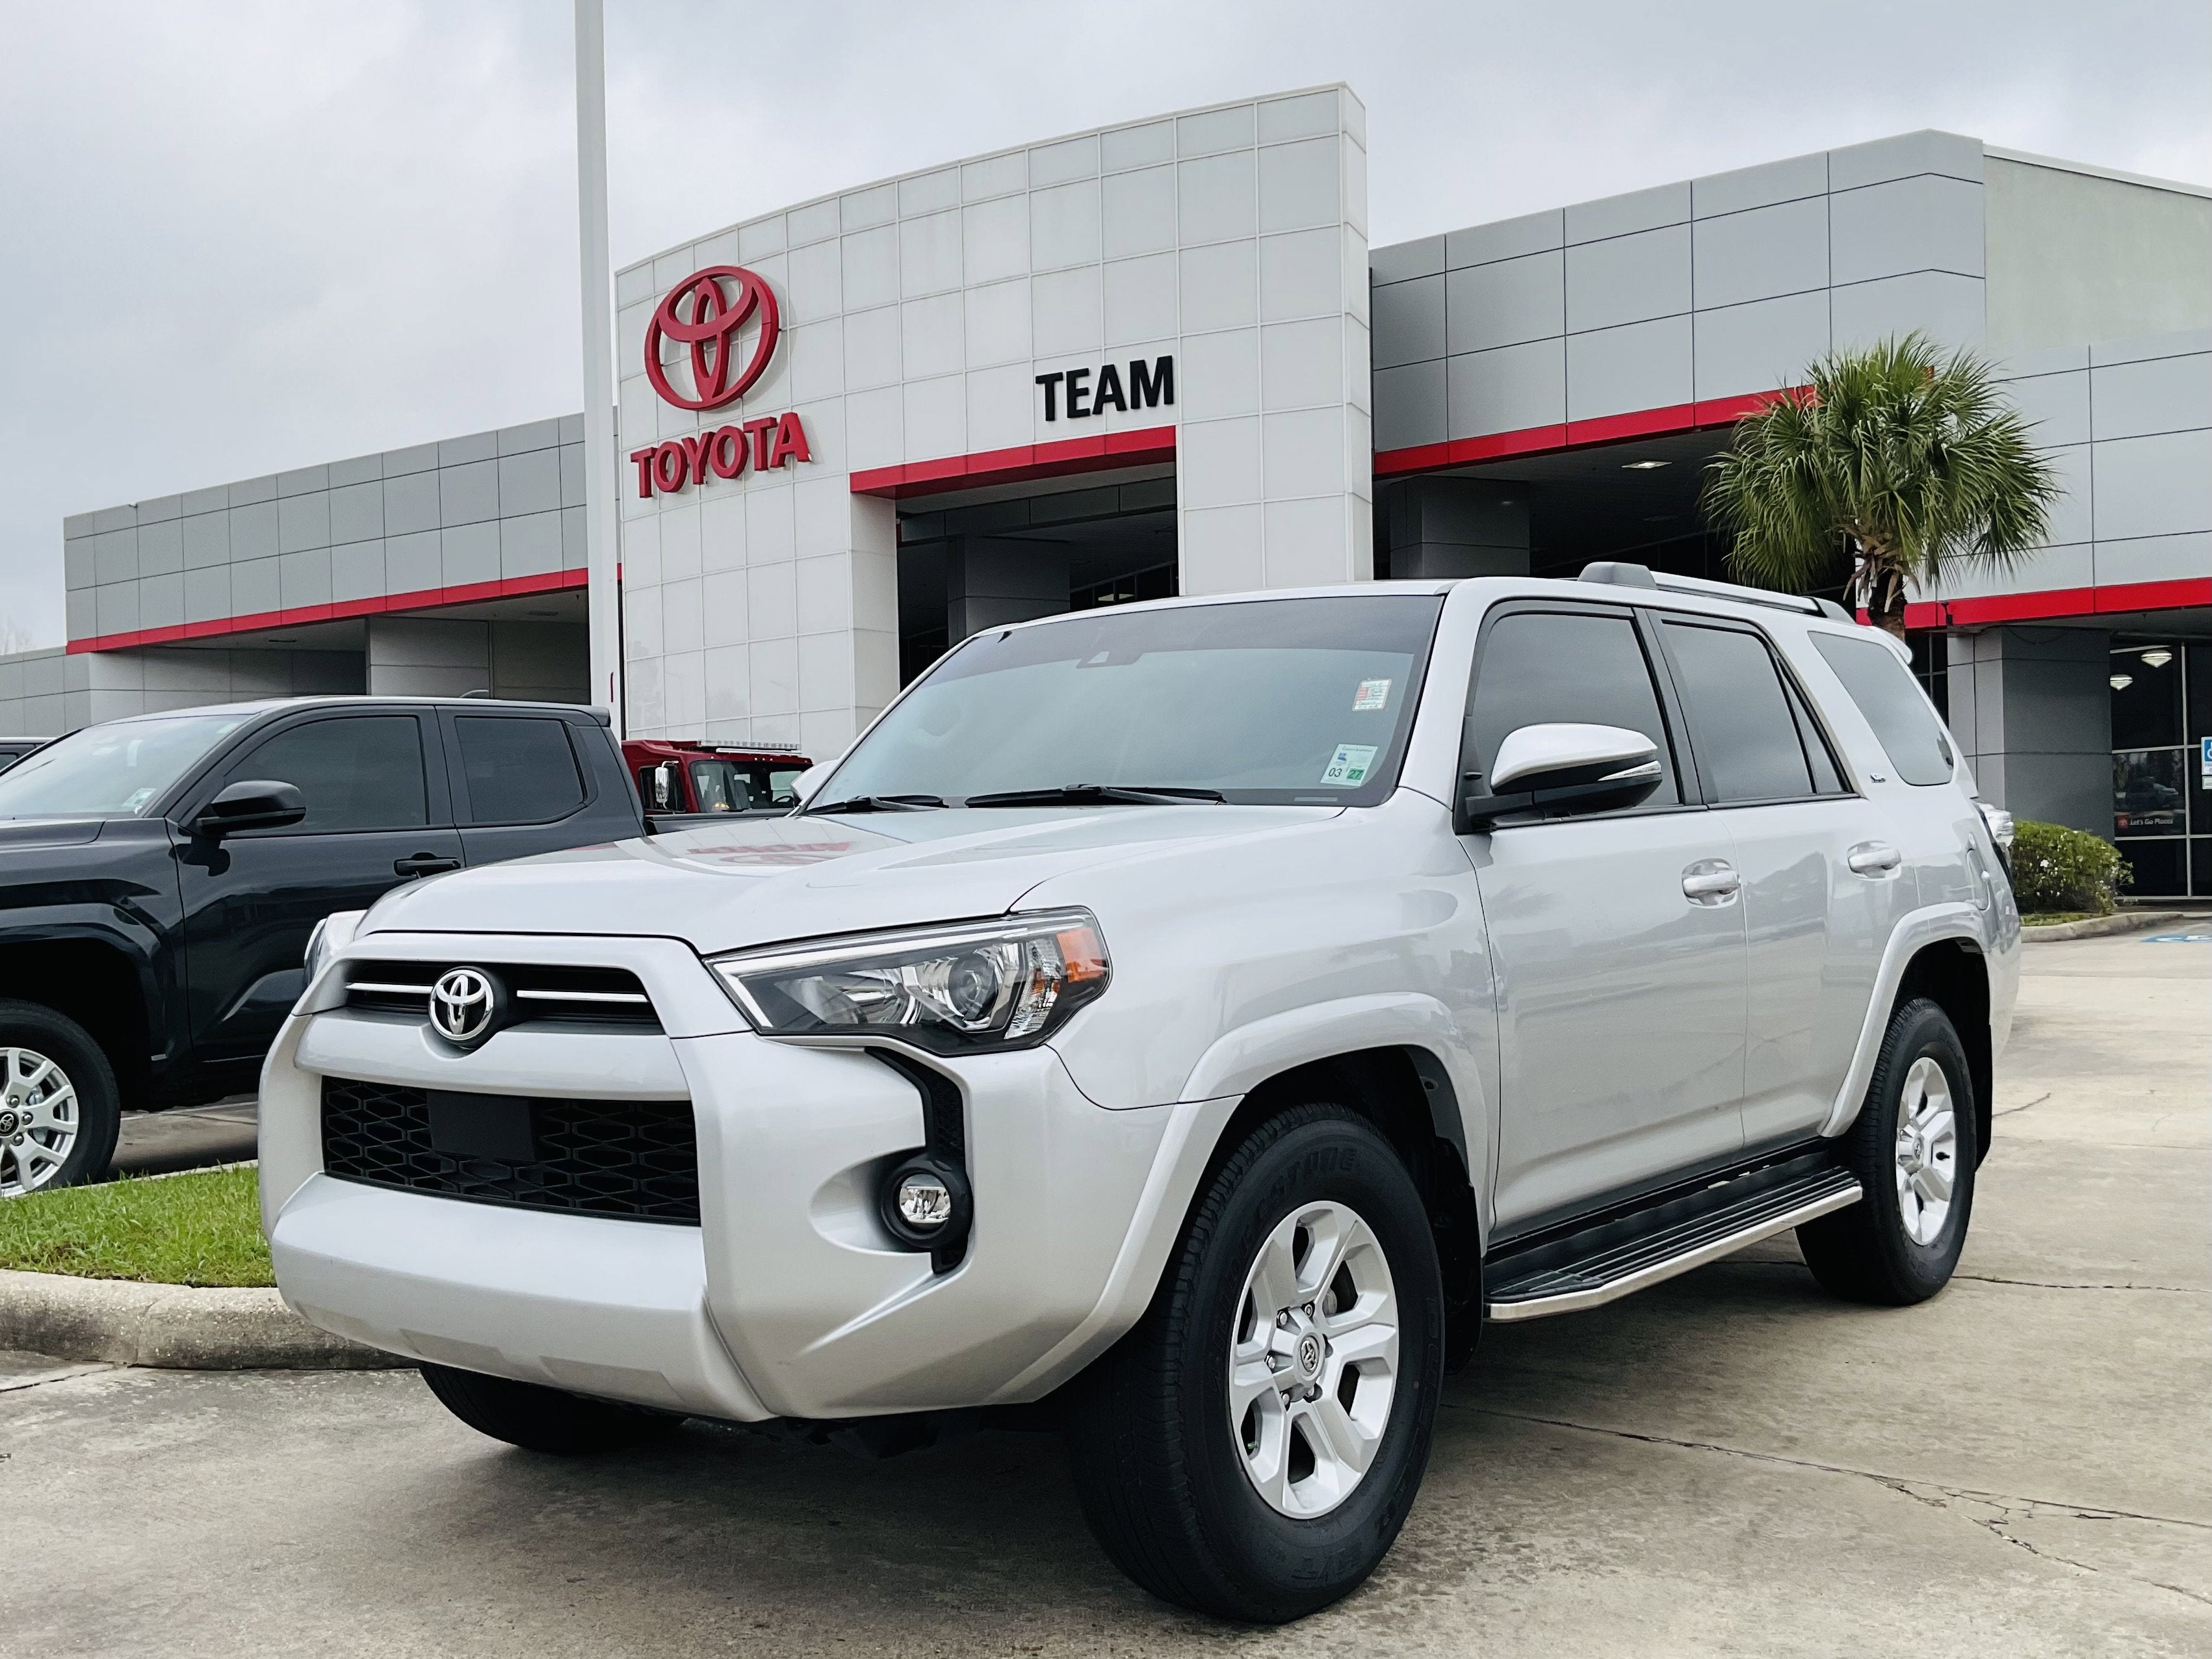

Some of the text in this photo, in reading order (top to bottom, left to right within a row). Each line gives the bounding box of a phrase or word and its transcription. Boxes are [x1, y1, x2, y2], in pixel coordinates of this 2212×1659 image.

[1035, 355, 1174, 421] TEAM
[631, 412, 812, 499] TOYOTA
[1329, 768, 1364, 779] 03 27
